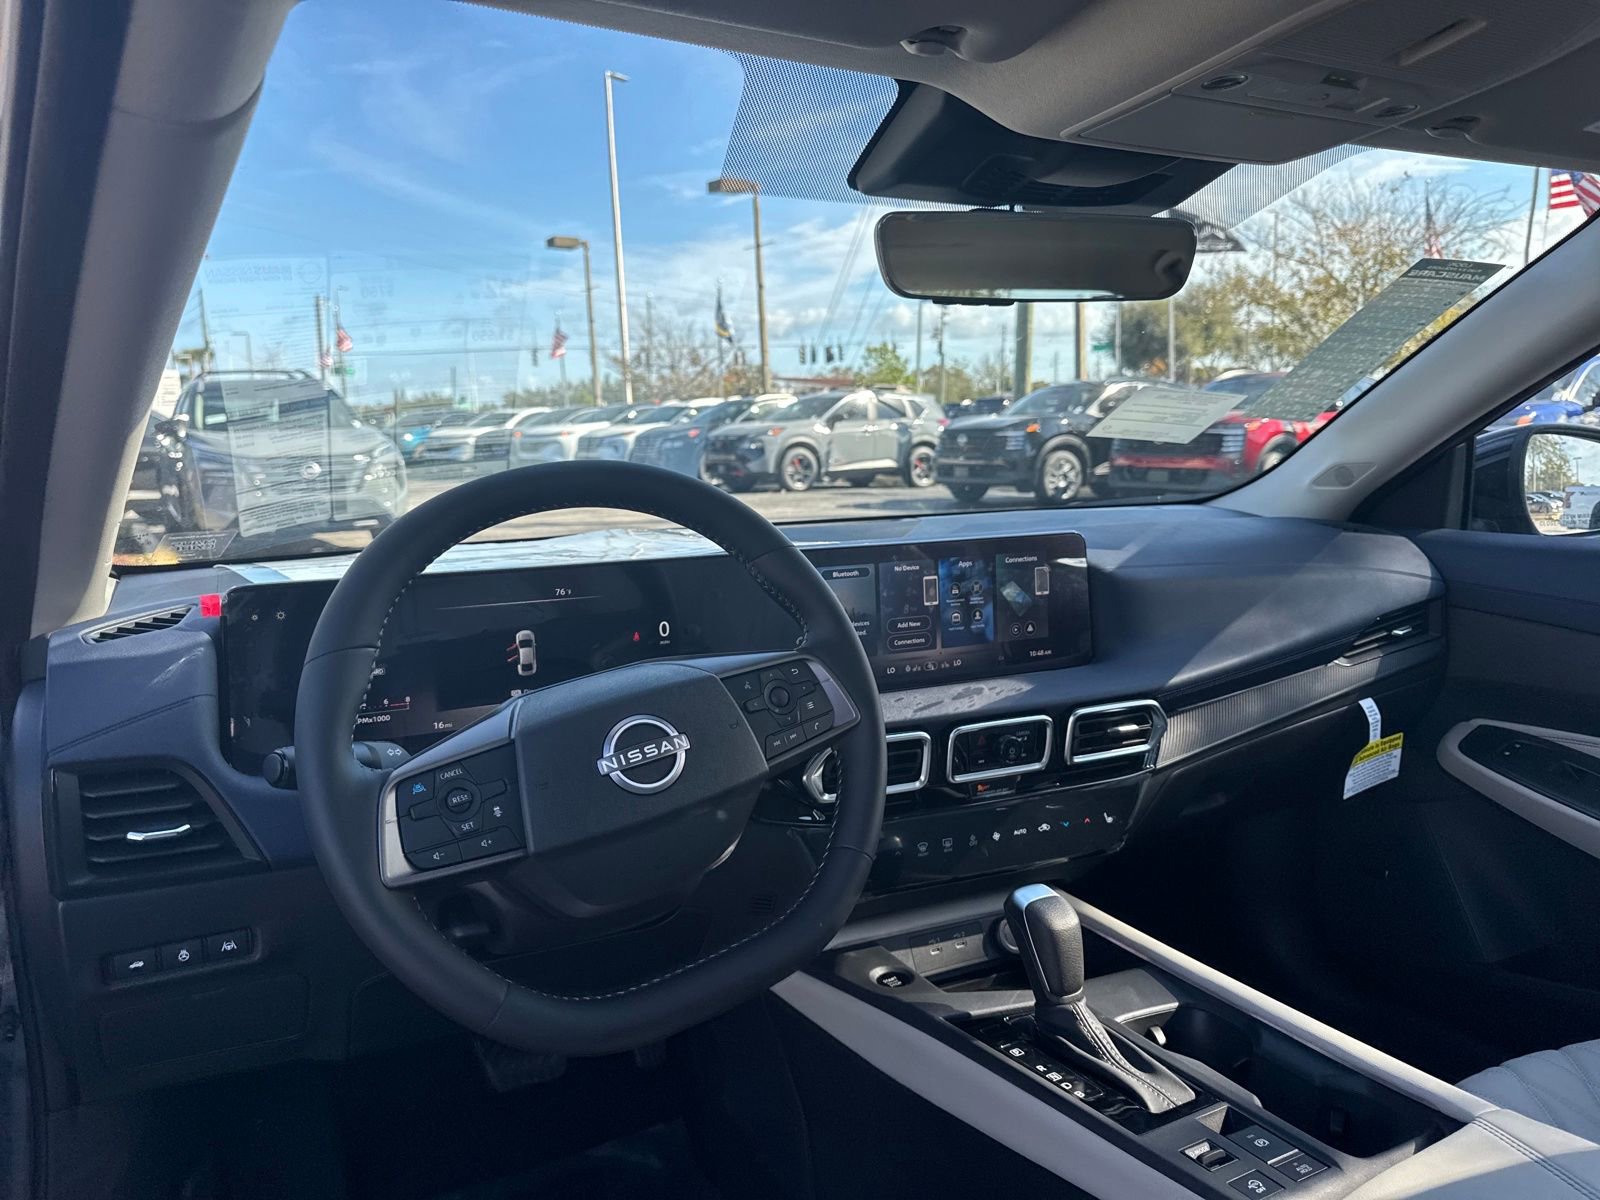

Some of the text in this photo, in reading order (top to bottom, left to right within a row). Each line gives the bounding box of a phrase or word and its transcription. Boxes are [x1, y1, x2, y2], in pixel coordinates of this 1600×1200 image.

[958, 559, 973, 568] Apps
[1005, 555, 1038, 564] Connections
[832, 570, 860, 578] Bluetooth
[658, 620, 670, 638] 0
[894, 637, 926, 646] Connections
[357, 714, 391, 724] PMx1000
[600, 734, 688, 771] NISSAN
[440, 768, 463, 780] CANCEL
[461, 821, 474, 831] SET
[1060, 1081, 1073, 1090] D
